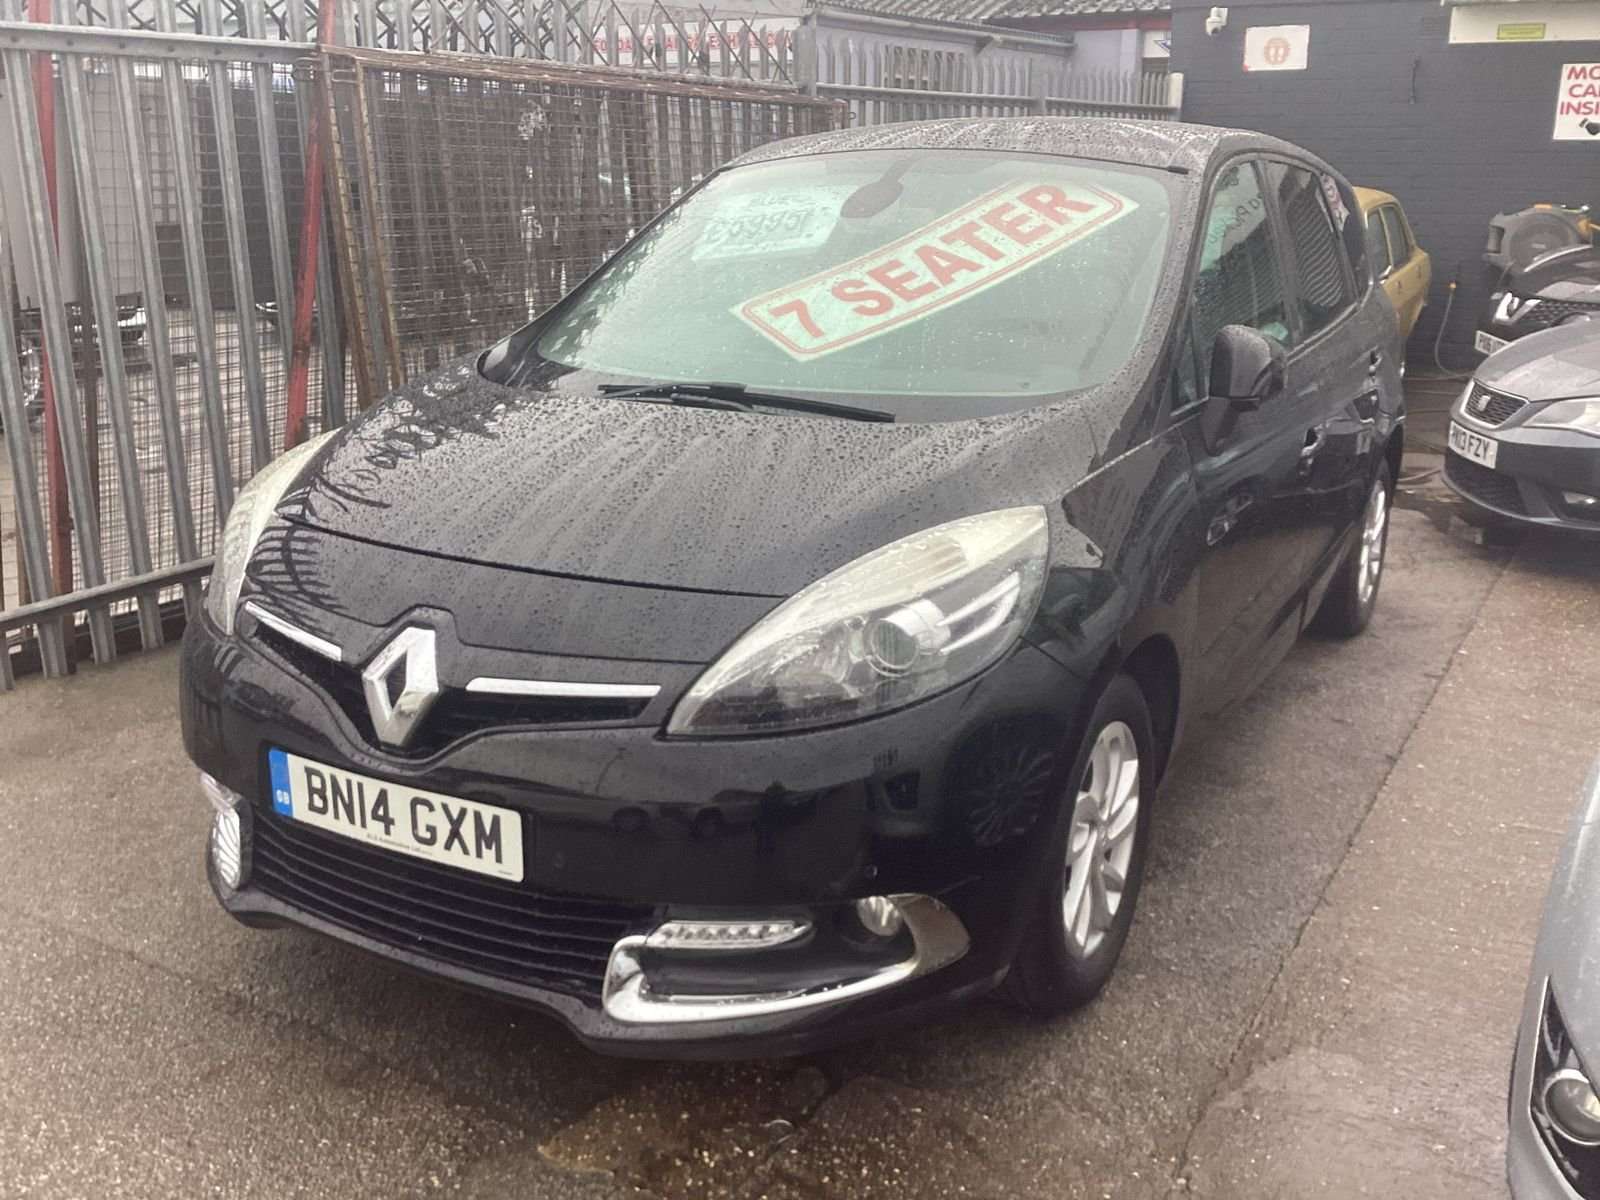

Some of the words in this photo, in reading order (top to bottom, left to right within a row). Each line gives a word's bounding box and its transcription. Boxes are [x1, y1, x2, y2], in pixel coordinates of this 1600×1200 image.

[1569, 84, 1600, 98] CA
[768, 299, 826, 339] 7
[831, 184, 1097, 317] SEATER
[1468, 434, 1490, 460] FZY
[304, 765, 395, 836] BN14
[410, 796, 504, 864] GXM
